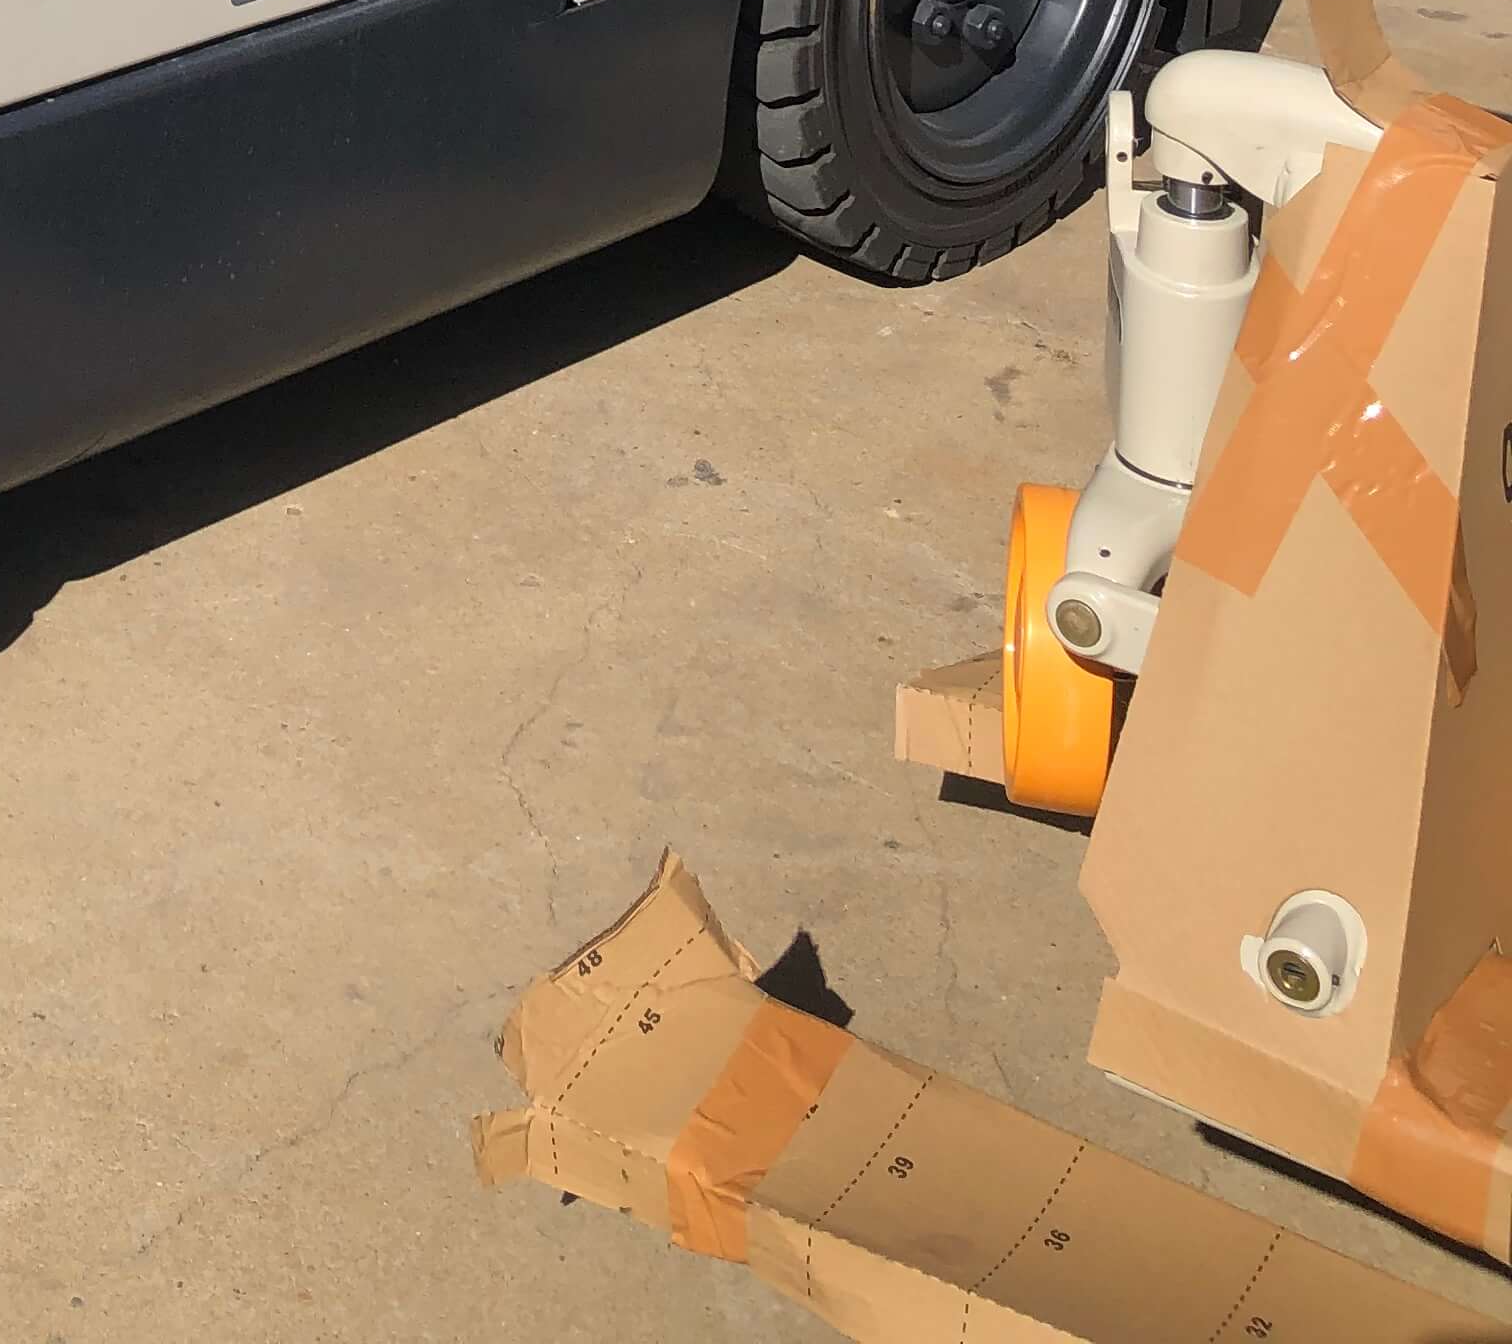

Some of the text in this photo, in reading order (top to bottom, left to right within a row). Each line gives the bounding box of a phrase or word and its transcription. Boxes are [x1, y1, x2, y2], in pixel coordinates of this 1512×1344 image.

[575, 949, 604, 979] 48
[637, 1007, 663, 1036] 45
[887, 1155, 915, 1180] 39
[1043, 1228, 1072, 1253] 36
